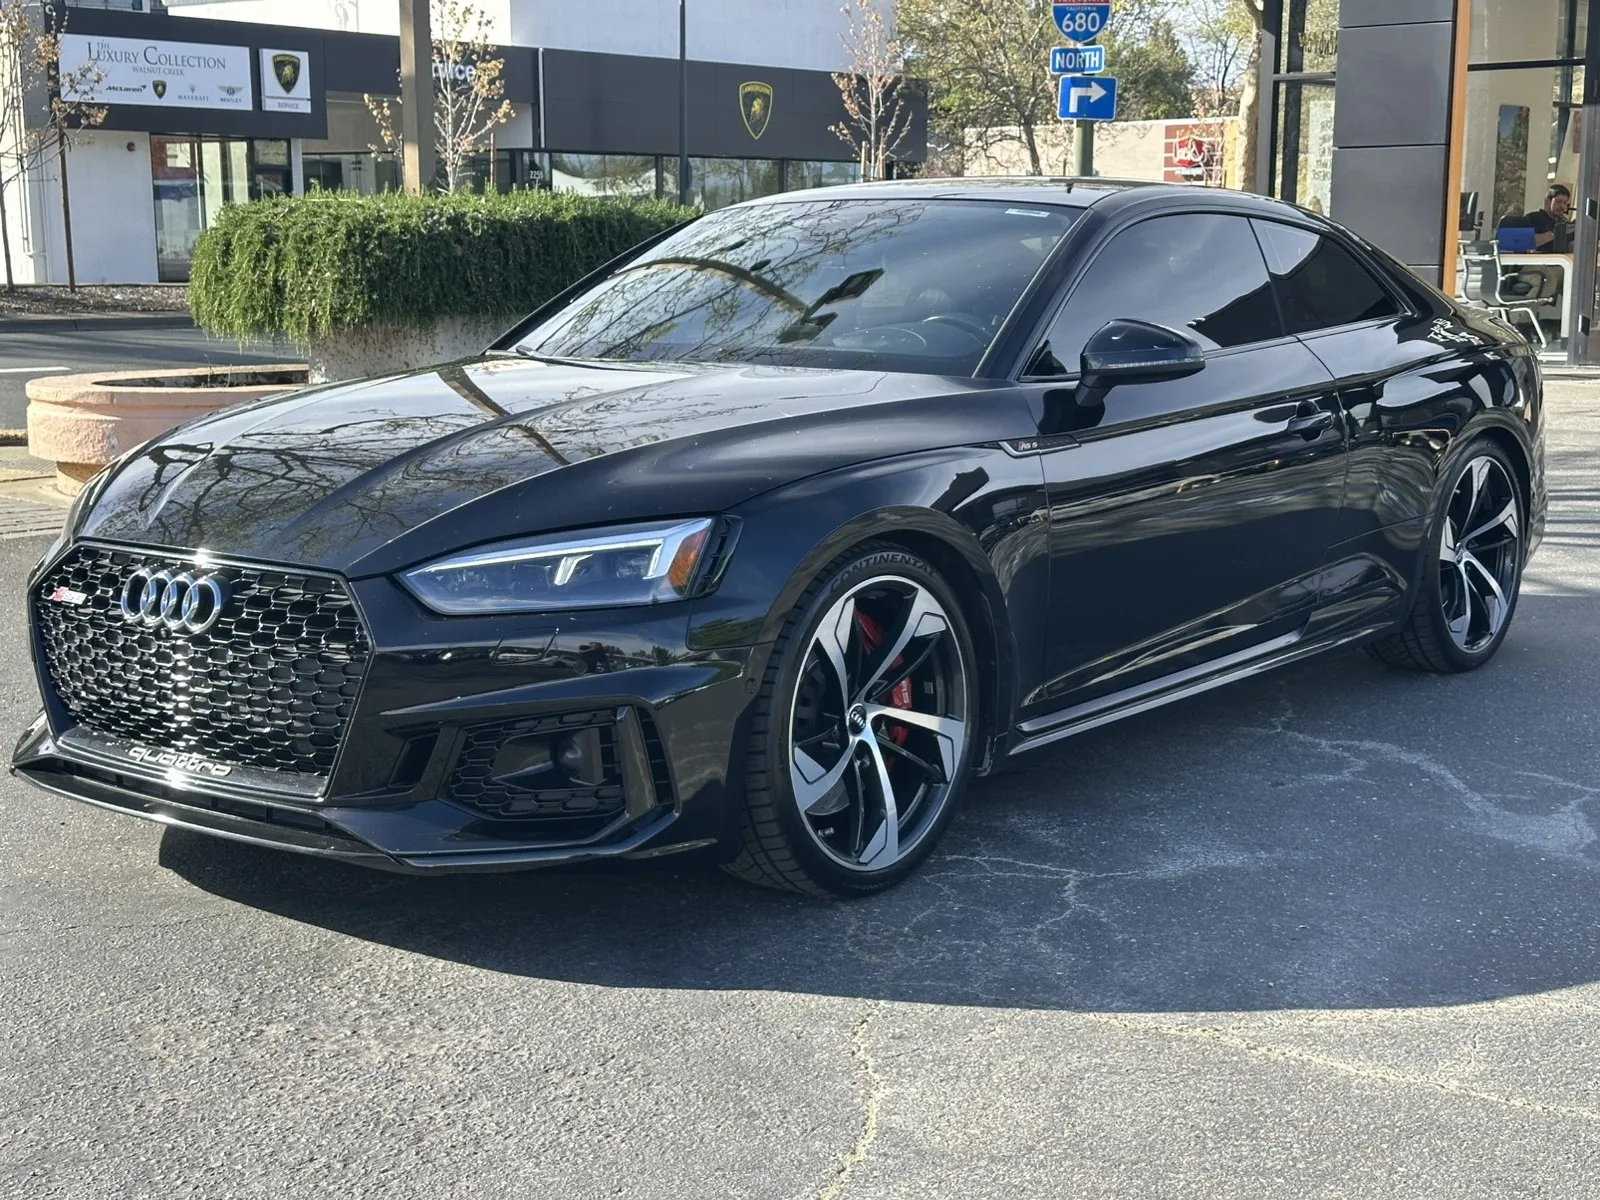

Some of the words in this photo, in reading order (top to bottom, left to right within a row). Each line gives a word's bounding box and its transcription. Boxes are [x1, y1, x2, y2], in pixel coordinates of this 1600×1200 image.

[1062, 13, 1100, 33] 680
[87, 42, 139, 64] LUXURY
[143, 45, 226, 70] COLLECTION
[1055, 50, 1100, 69] NORTH
[132, 66, 161, 75] WALNUT
[163, 67, 185, 76] CREEK
[106, 85, 143, 93] McLaren
[177, 94, 209, 102] MASERATI
[830, 552, 937, 590] CONTINENTAL
[128, 746, 232, 777] quattro
